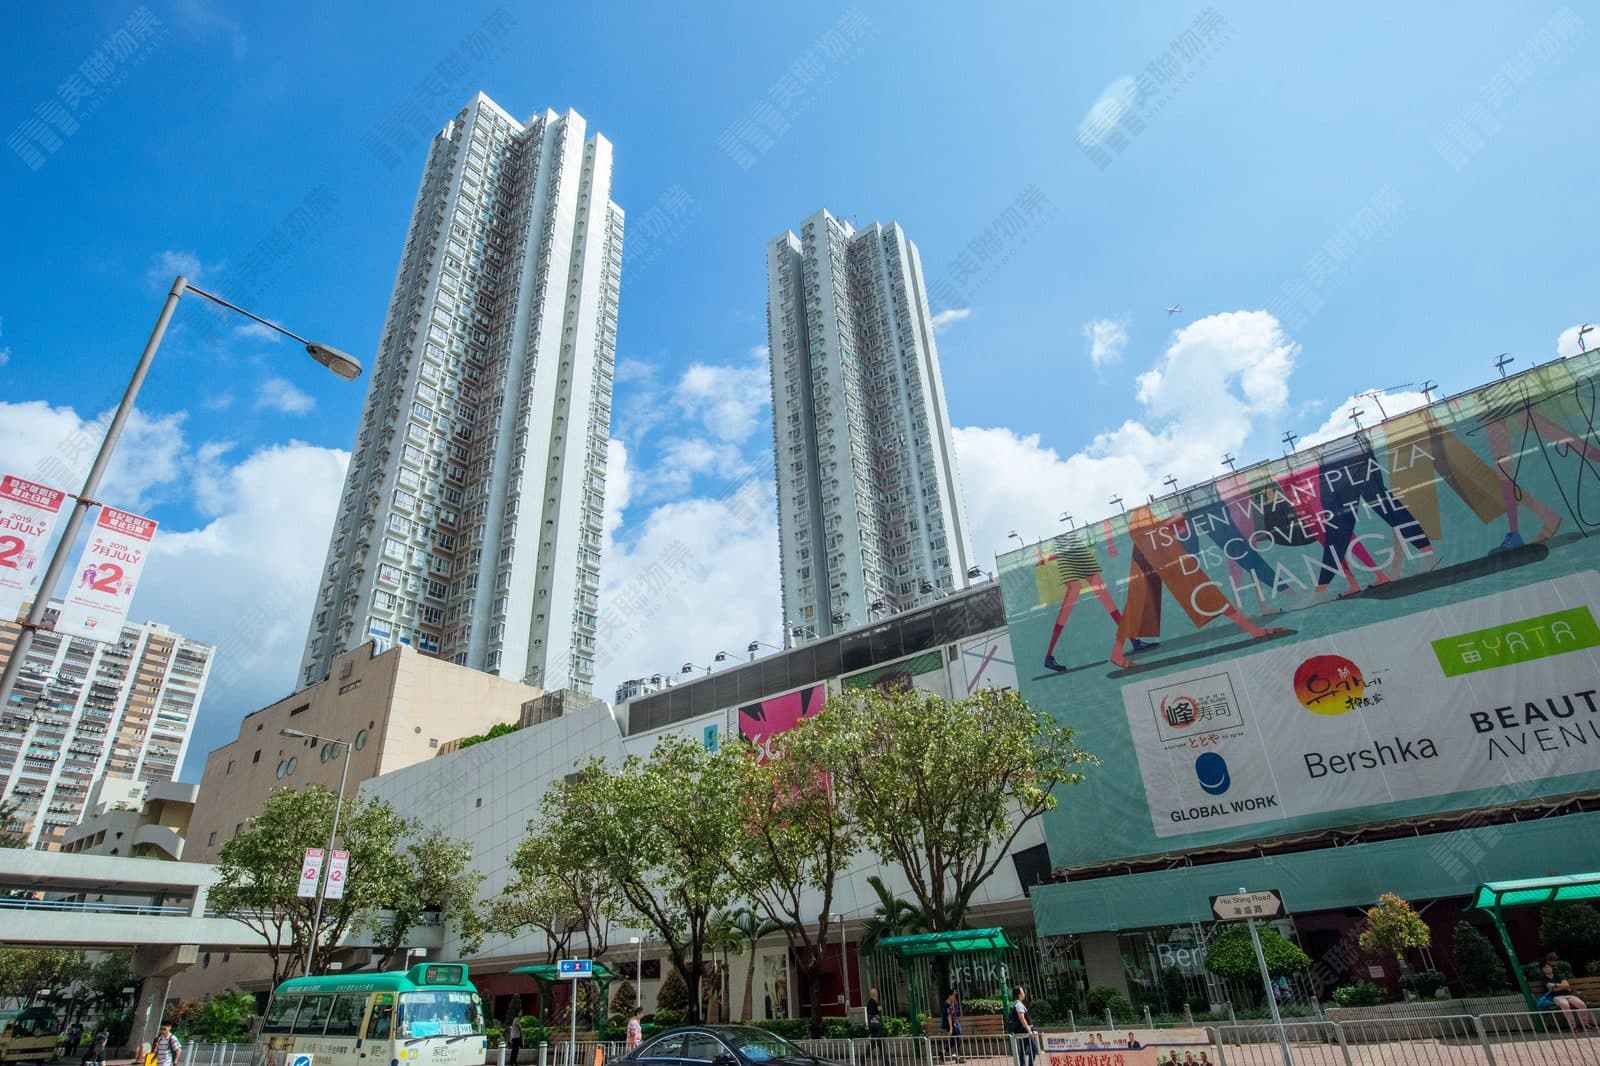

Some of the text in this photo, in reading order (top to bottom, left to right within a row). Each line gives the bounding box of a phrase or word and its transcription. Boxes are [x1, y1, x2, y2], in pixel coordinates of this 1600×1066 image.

[1145, 444, 1435, 550] TSUEN WAN PLAZA
[10, 513, 32, 524] 2019
[1179, 488, 1408, 577] DISCOVER THE
[0, 535, 25, 569] 2
[109, 542, 129, 552] 2019
[91, 563, 124, 595] 2
[1190, 520, 1433, 617] CHANGE
[1482, 621, 1576, 657] YATA
[1470, 689, 1598, 734] BEAUT
[1189, 733, 1220, 749] ととや
[1303, 736, 1439, 779] Bershka
[1170, 795, 1278, 822] GLOBAL WORK
[1232, 896, 1252, 904] Shing
